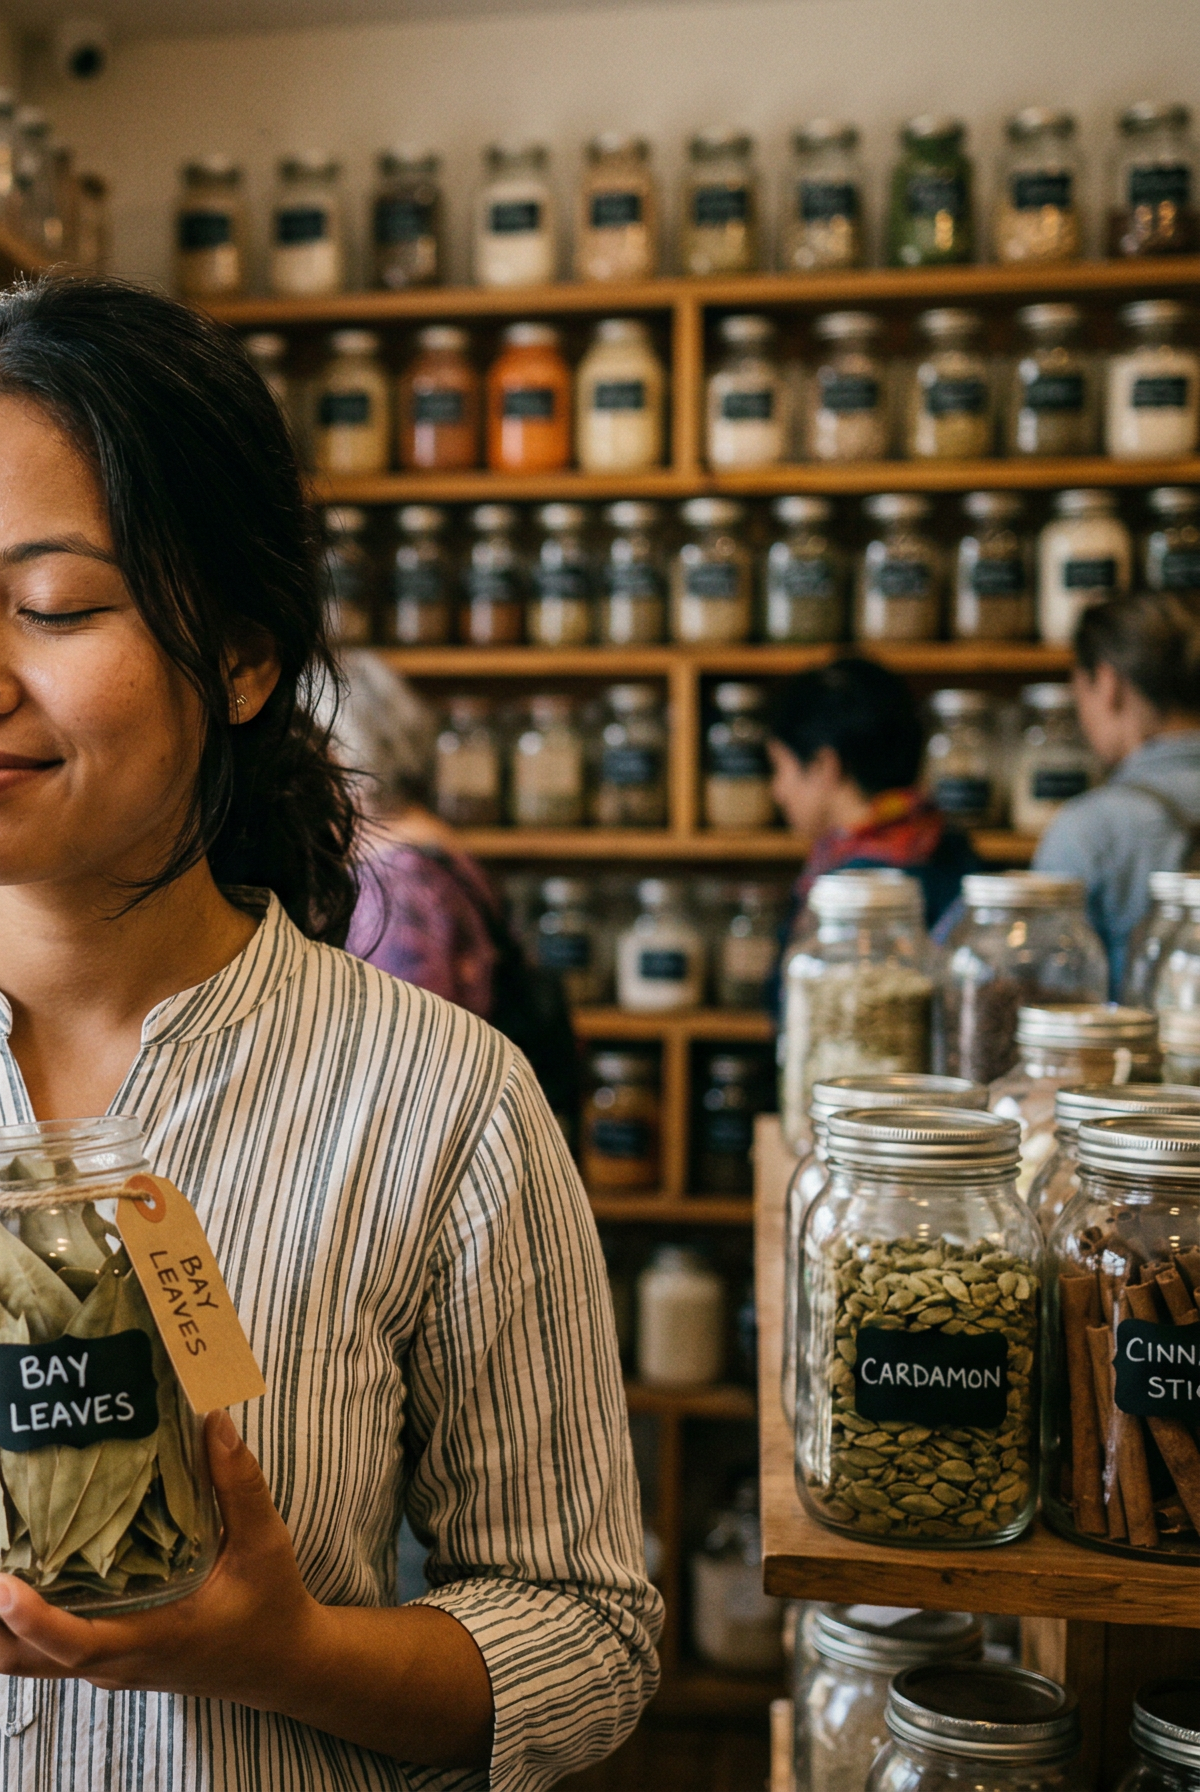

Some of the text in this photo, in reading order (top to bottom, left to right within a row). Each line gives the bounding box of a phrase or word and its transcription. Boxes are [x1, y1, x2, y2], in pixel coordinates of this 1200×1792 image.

[179, 1254, 219, 1311] BAY
[148, 1250, 207, 1357] LEAVES
[1126, 1337, 1200, 1365] CINN
[19, 1352, 89, 1390] BAY
[861, 1357, 1001, 1389] CARDAMON
[1147, 1376, 1200, 1400] STI
[9, 1392, 135, 1433] LEAVES
